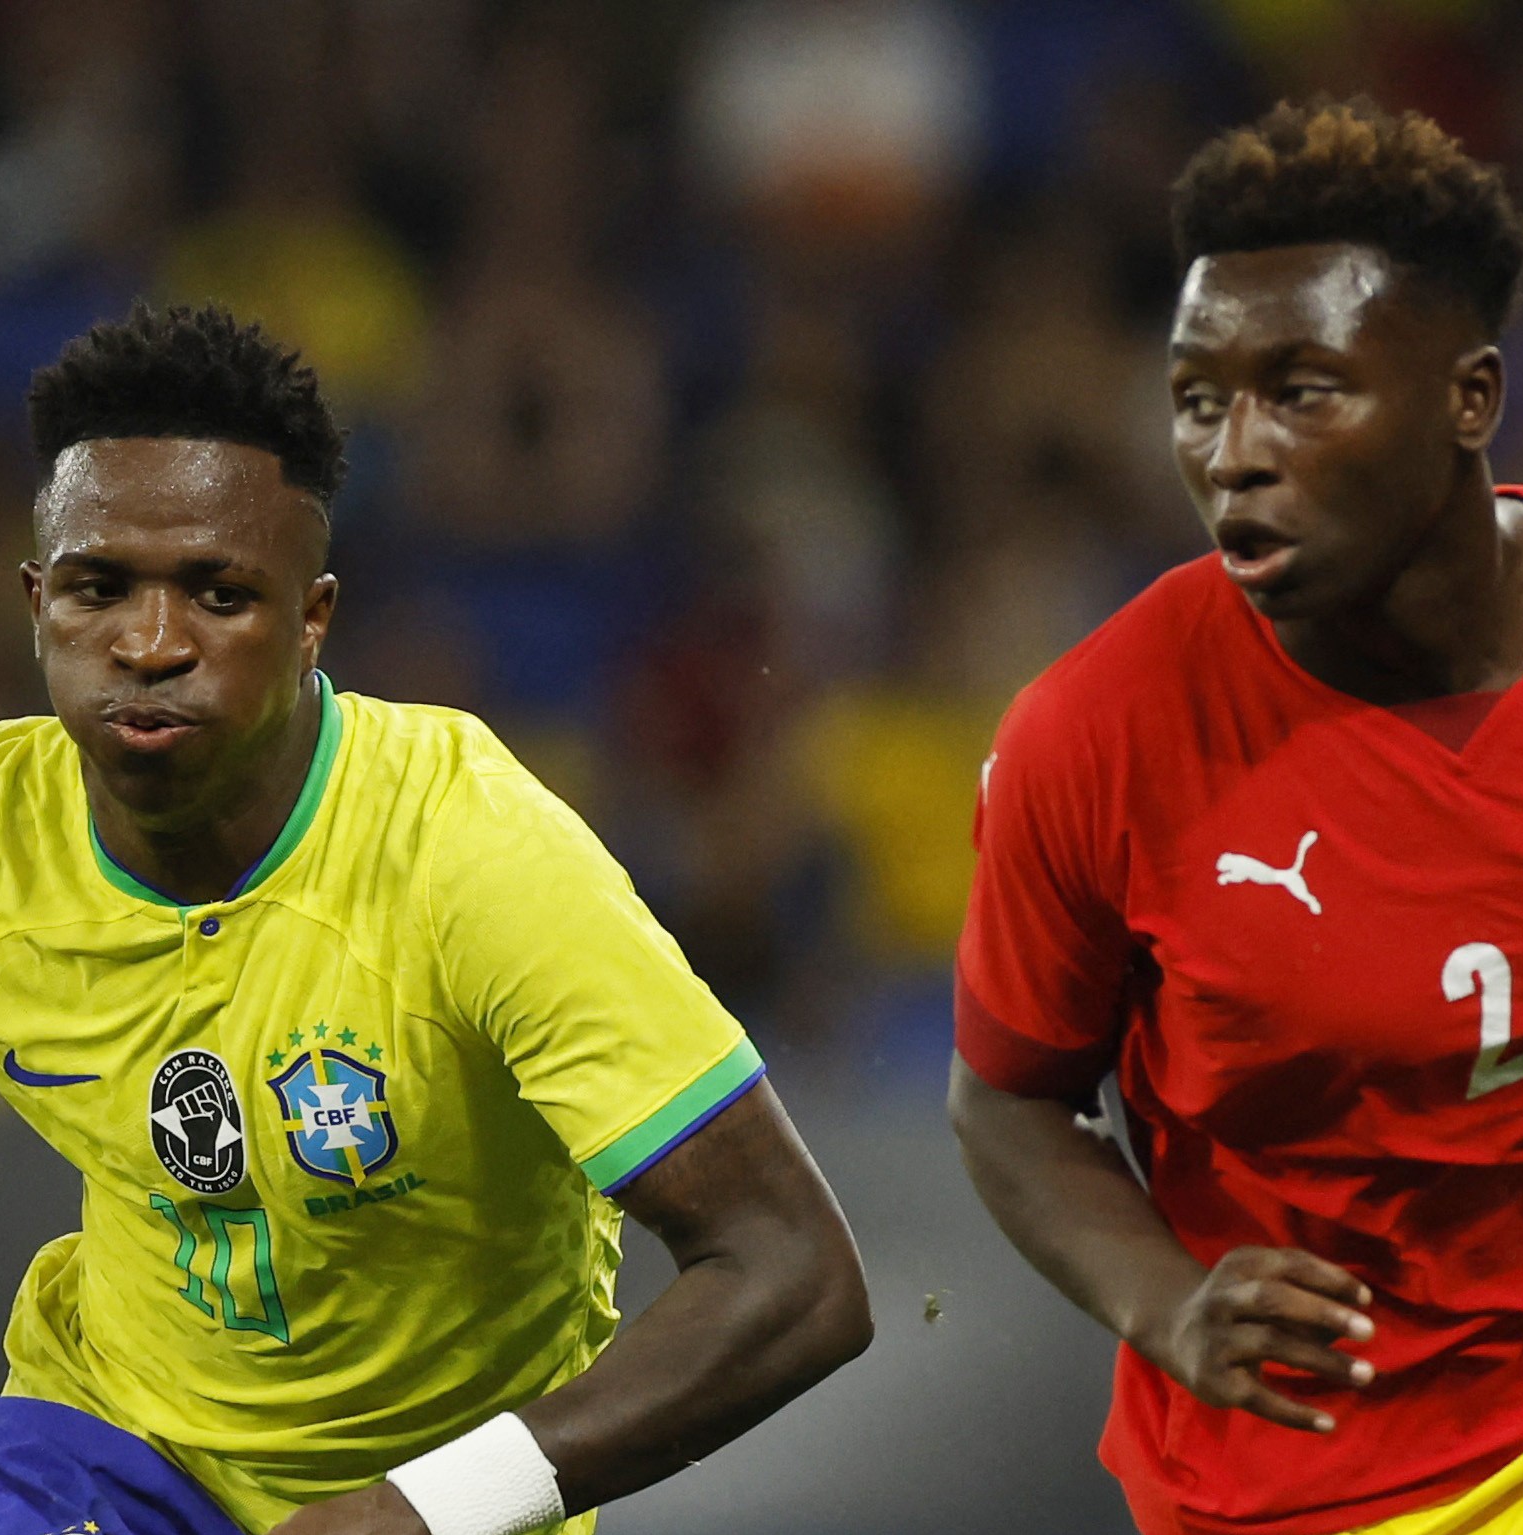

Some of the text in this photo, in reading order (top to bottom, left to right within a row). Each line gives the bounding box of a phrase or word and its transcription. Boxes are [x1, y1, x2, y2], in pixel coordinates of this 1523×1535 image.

[158, 1055, 234, 1101] COM RACISMO
[314, 1107, 356, 1127] CBF
[162, 1155, 184, 1180] NÃO
[189, 1179, 213, 1192] TEM
[192, 1154, 214, 1168] CBF
[304, 1171, 428, 1216] BRASIL
[149, 1193, 290, 1345] 10
